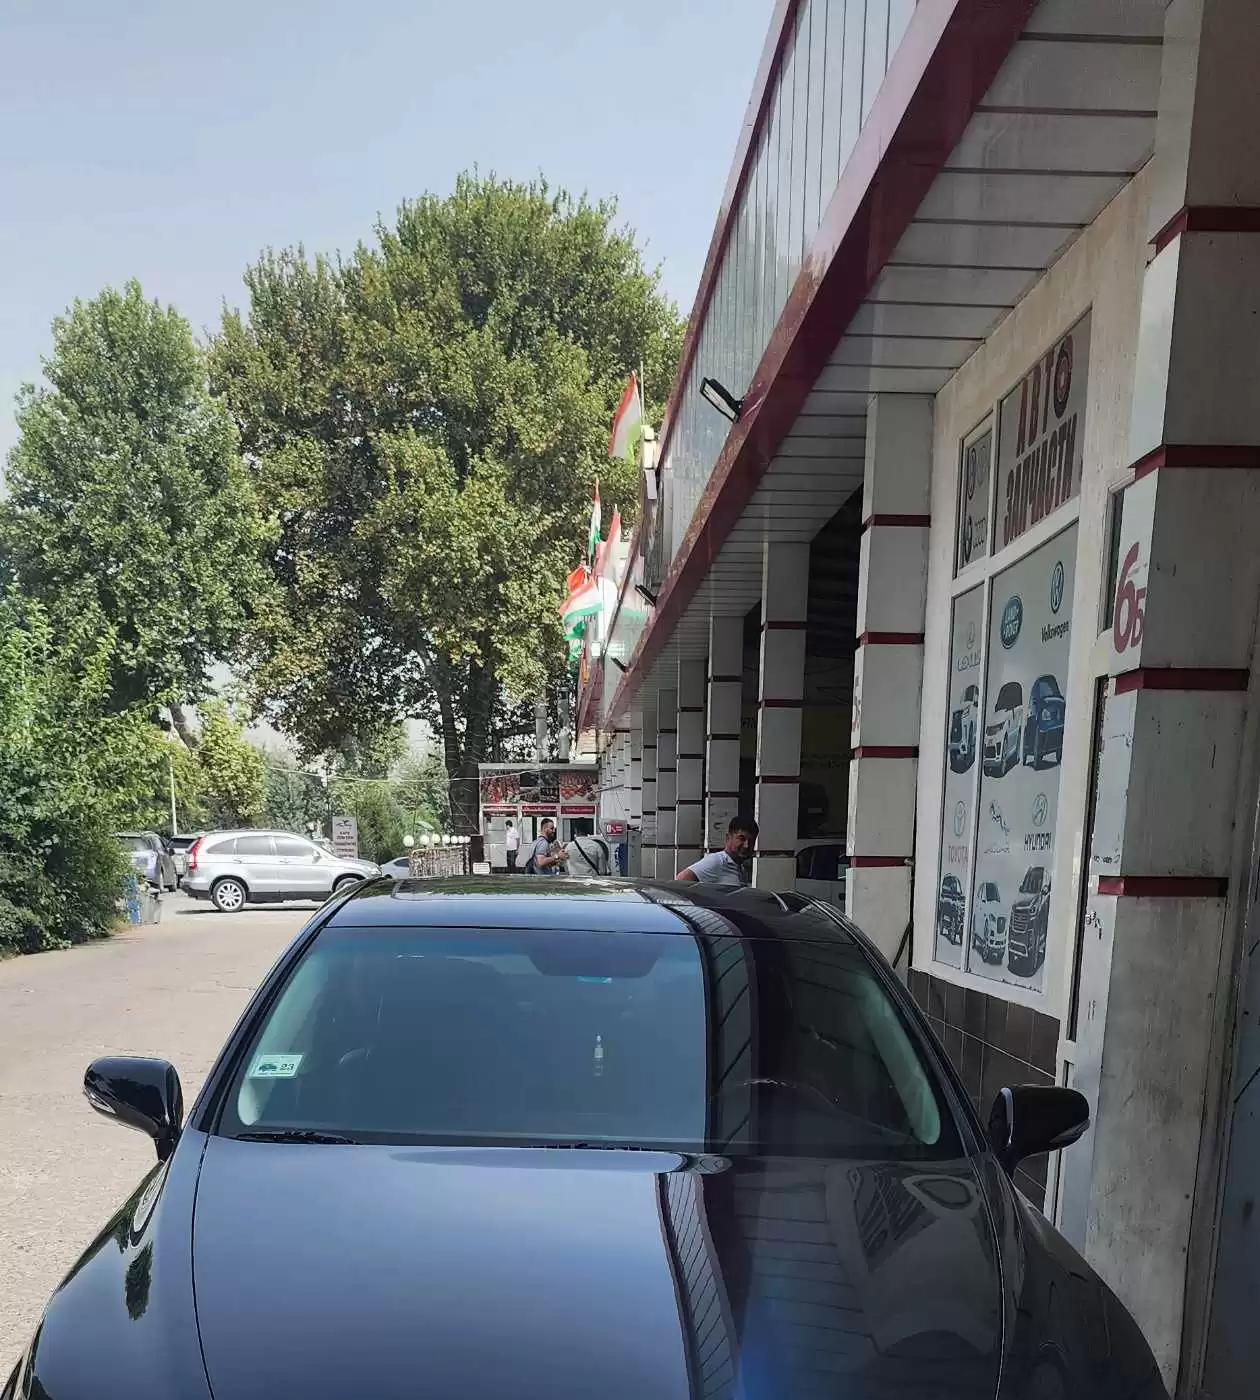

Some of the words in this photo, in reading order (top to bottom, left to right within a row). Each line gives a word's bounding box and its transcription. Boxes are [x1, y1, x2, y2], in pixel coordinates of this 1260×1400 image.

[1016, 335, 1074, 459] АВТО
[1003, 412, 1078, 546] ЗАПЧАСТИ
[1024, 832, 1051, 852] HYUNDAI
